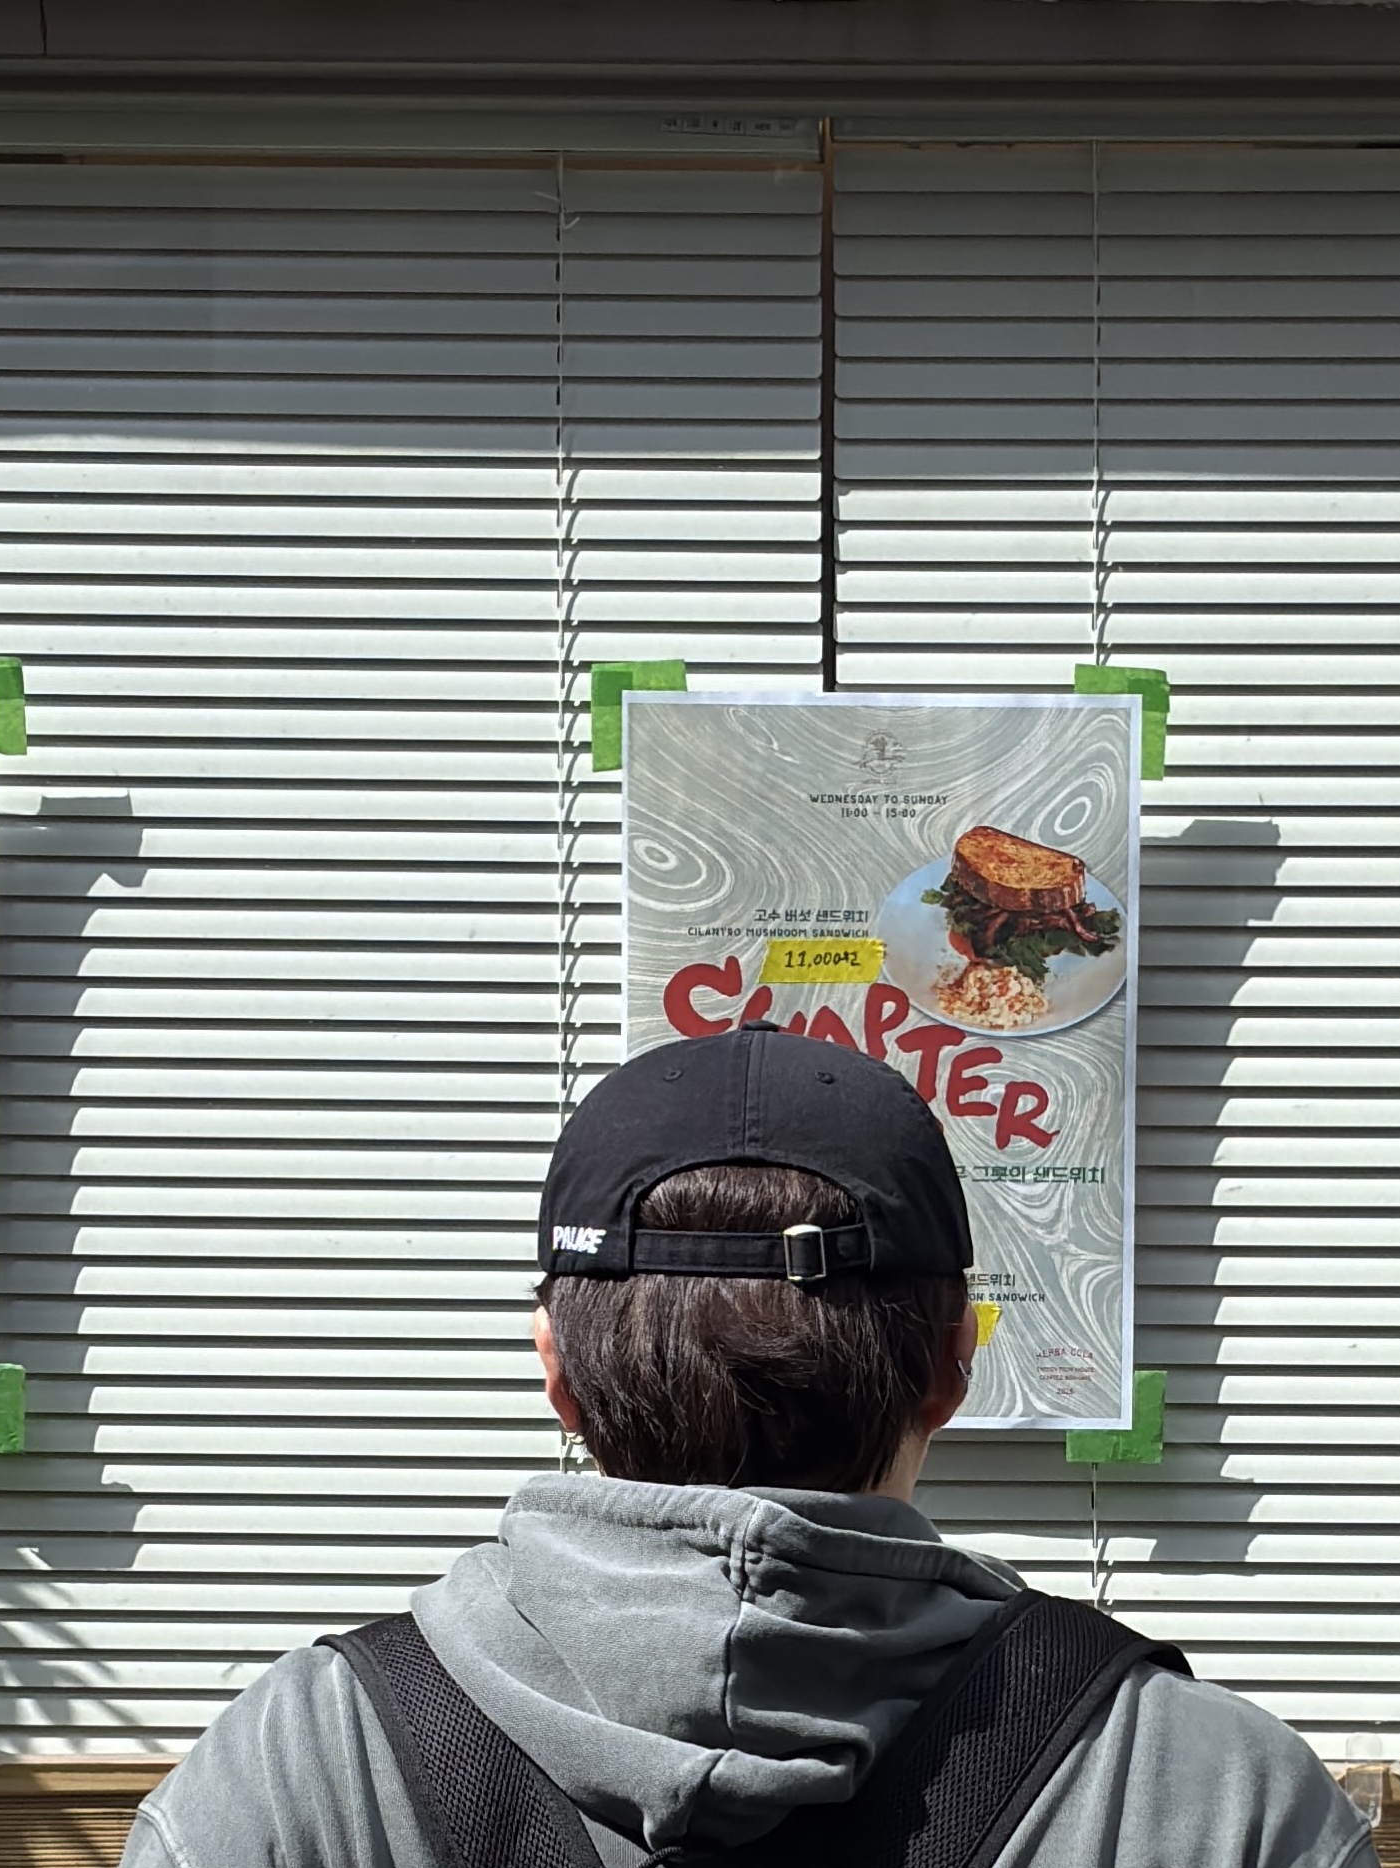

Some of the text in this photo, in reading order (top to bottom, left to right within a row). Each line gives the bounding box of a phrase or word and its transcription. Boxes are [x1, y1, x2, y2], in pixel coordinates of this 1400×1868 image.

[809, 794, 949, 805] WEDNESDAY TO SUNDAY
[754, 909, 869, 923] 고수 버섯 샌드위치
[688, 927, 869, 938] CILANTRO MUSHROOM SANDWICH
[1033, 1166, 1105, 1184] 샌드위치
[552, 1226, 607, 1254] PALACE
[989, 1293, 1045, 1302] SANDWICH
